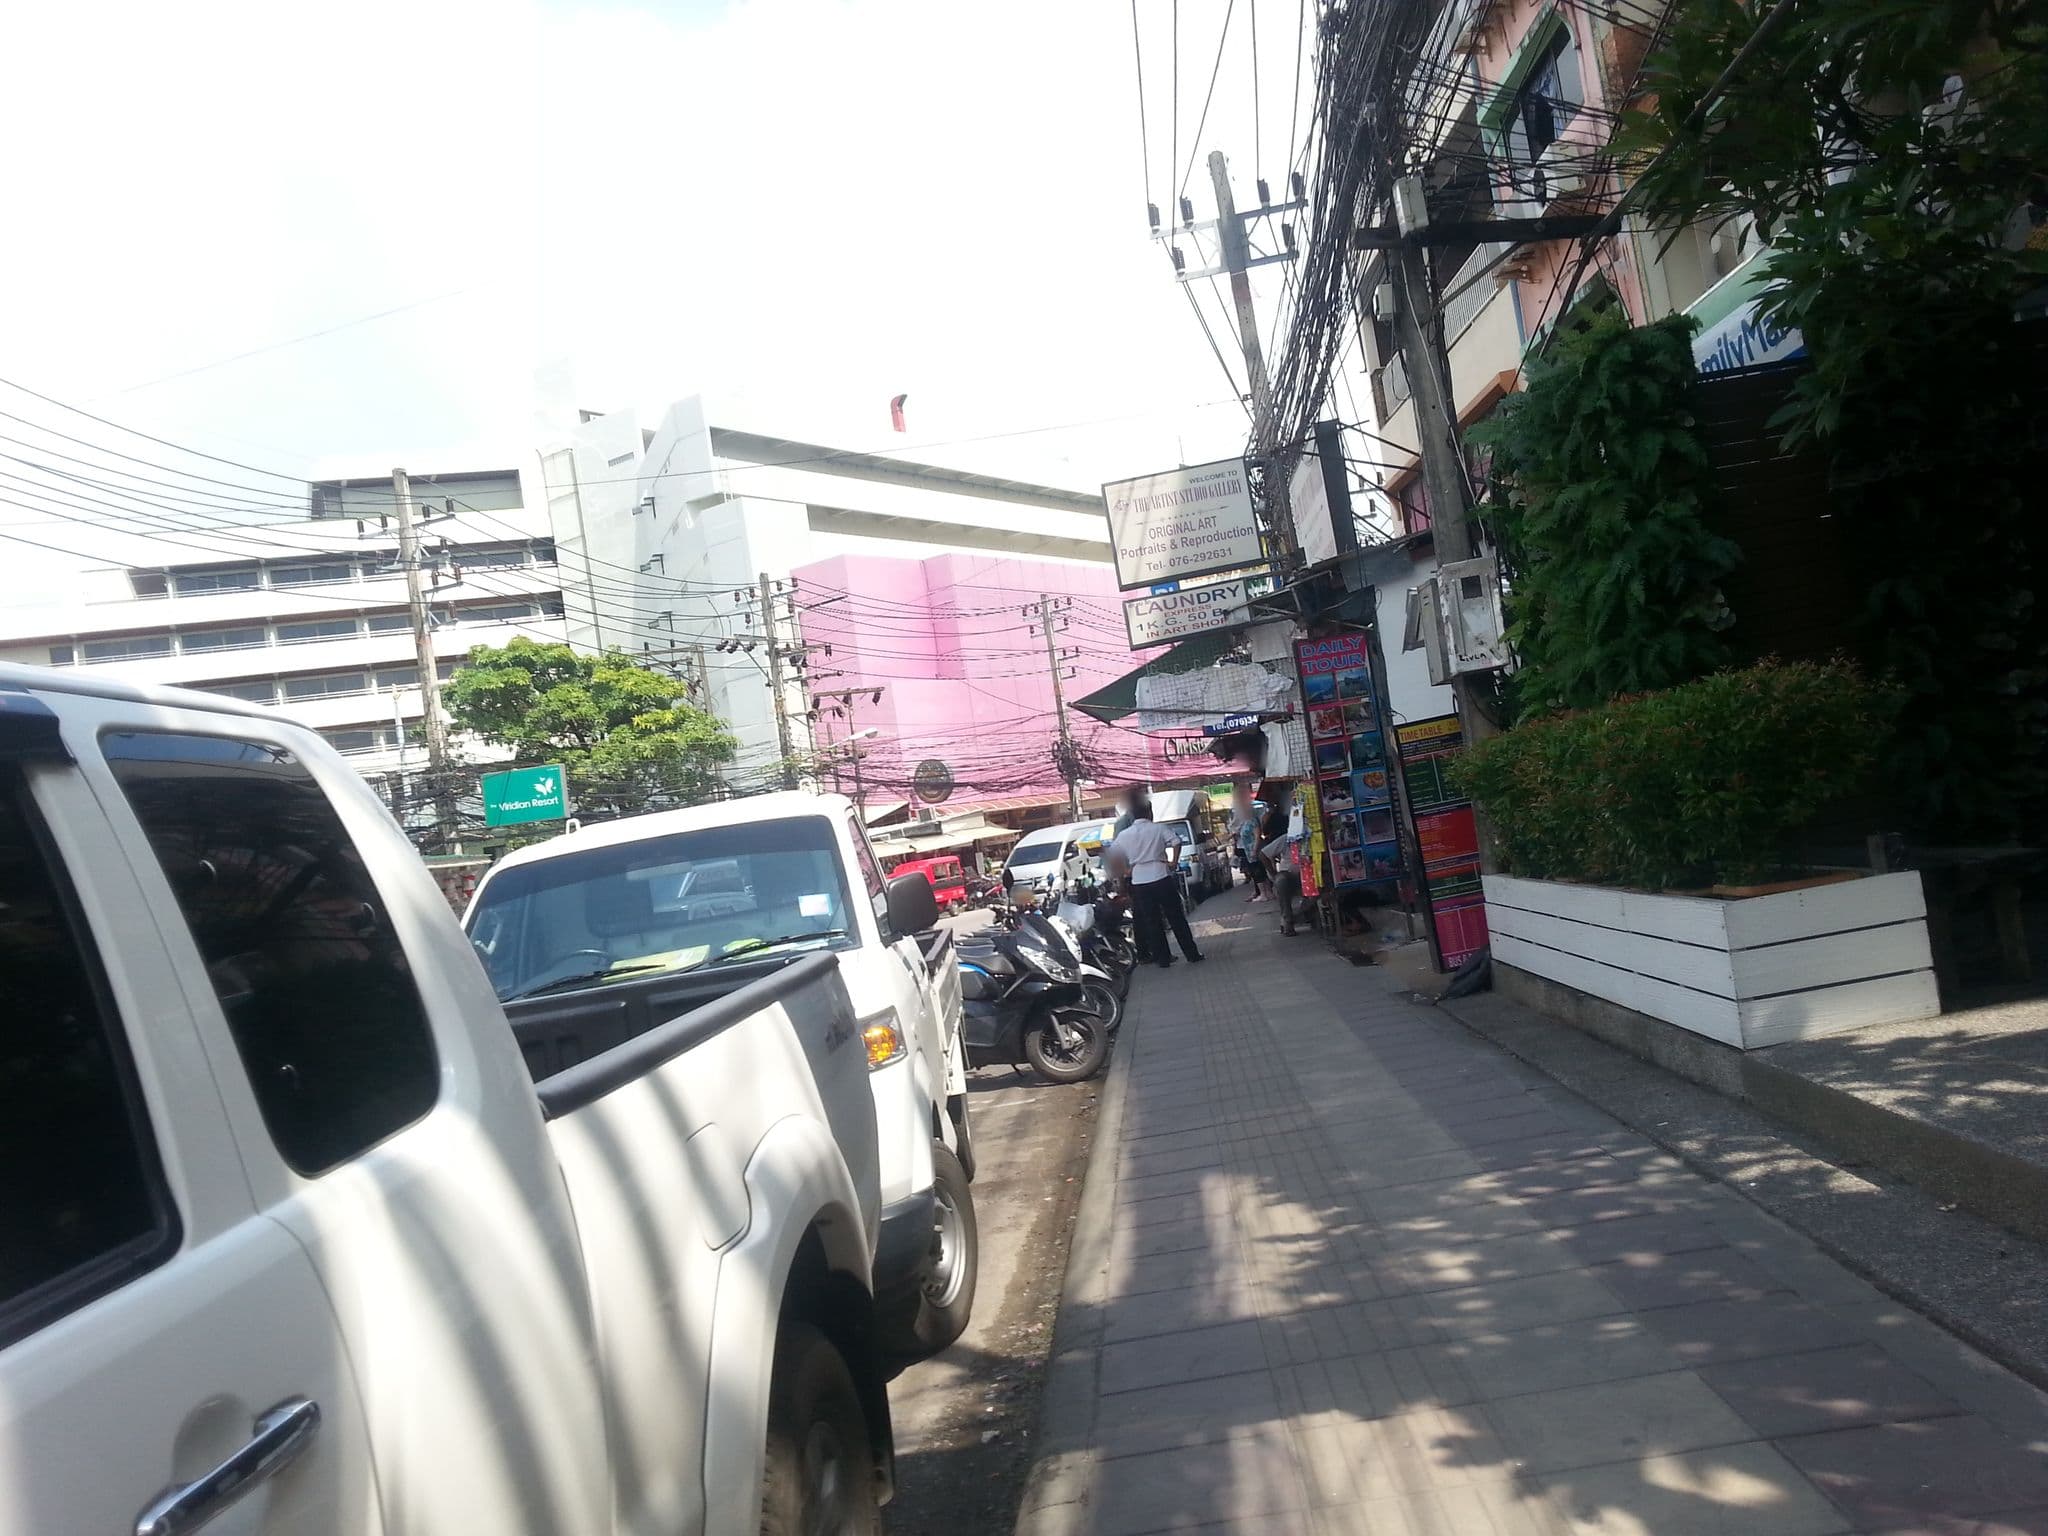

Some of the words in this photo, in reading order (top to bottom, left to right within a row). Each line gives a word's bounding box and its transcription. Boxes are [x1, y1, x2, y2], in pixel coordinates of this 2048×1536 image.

[1189, 473, 1226, 484] WELCOME
[1134, 496, 1150, 513] THE
[1150, 489, 1178, 510] ARTIST
[1179, 484, 1208, 504] STUDIO
[1208, 479, 1242, 498] GALLERY
[1148, 520, 1196, 540] ORIGINAL
[1199, 516, 1217, 533] ART
[1120, 542, 1167, 560] Portraits
[1170, 540, 1178, 550] &
[1181, 525, 1254, 548] Reproduction
[1169, 547, 1233, 567] 076-292631
[1135, 584, 1240, 617] LAUNDRY
[1164, 604, 1212, 618] EXPRESS
[1188, 611, 1207, 622] 50
[1147, 630, 1159, 639] IN
[1163, 625, 1188, 636] ART
[1300, 635, 1363, 658] DAILY
[1301, 652, 1365, 673] TOUR
[499, 800, 531, 811] Viridian
[532, 795, 559, 807] Resort
